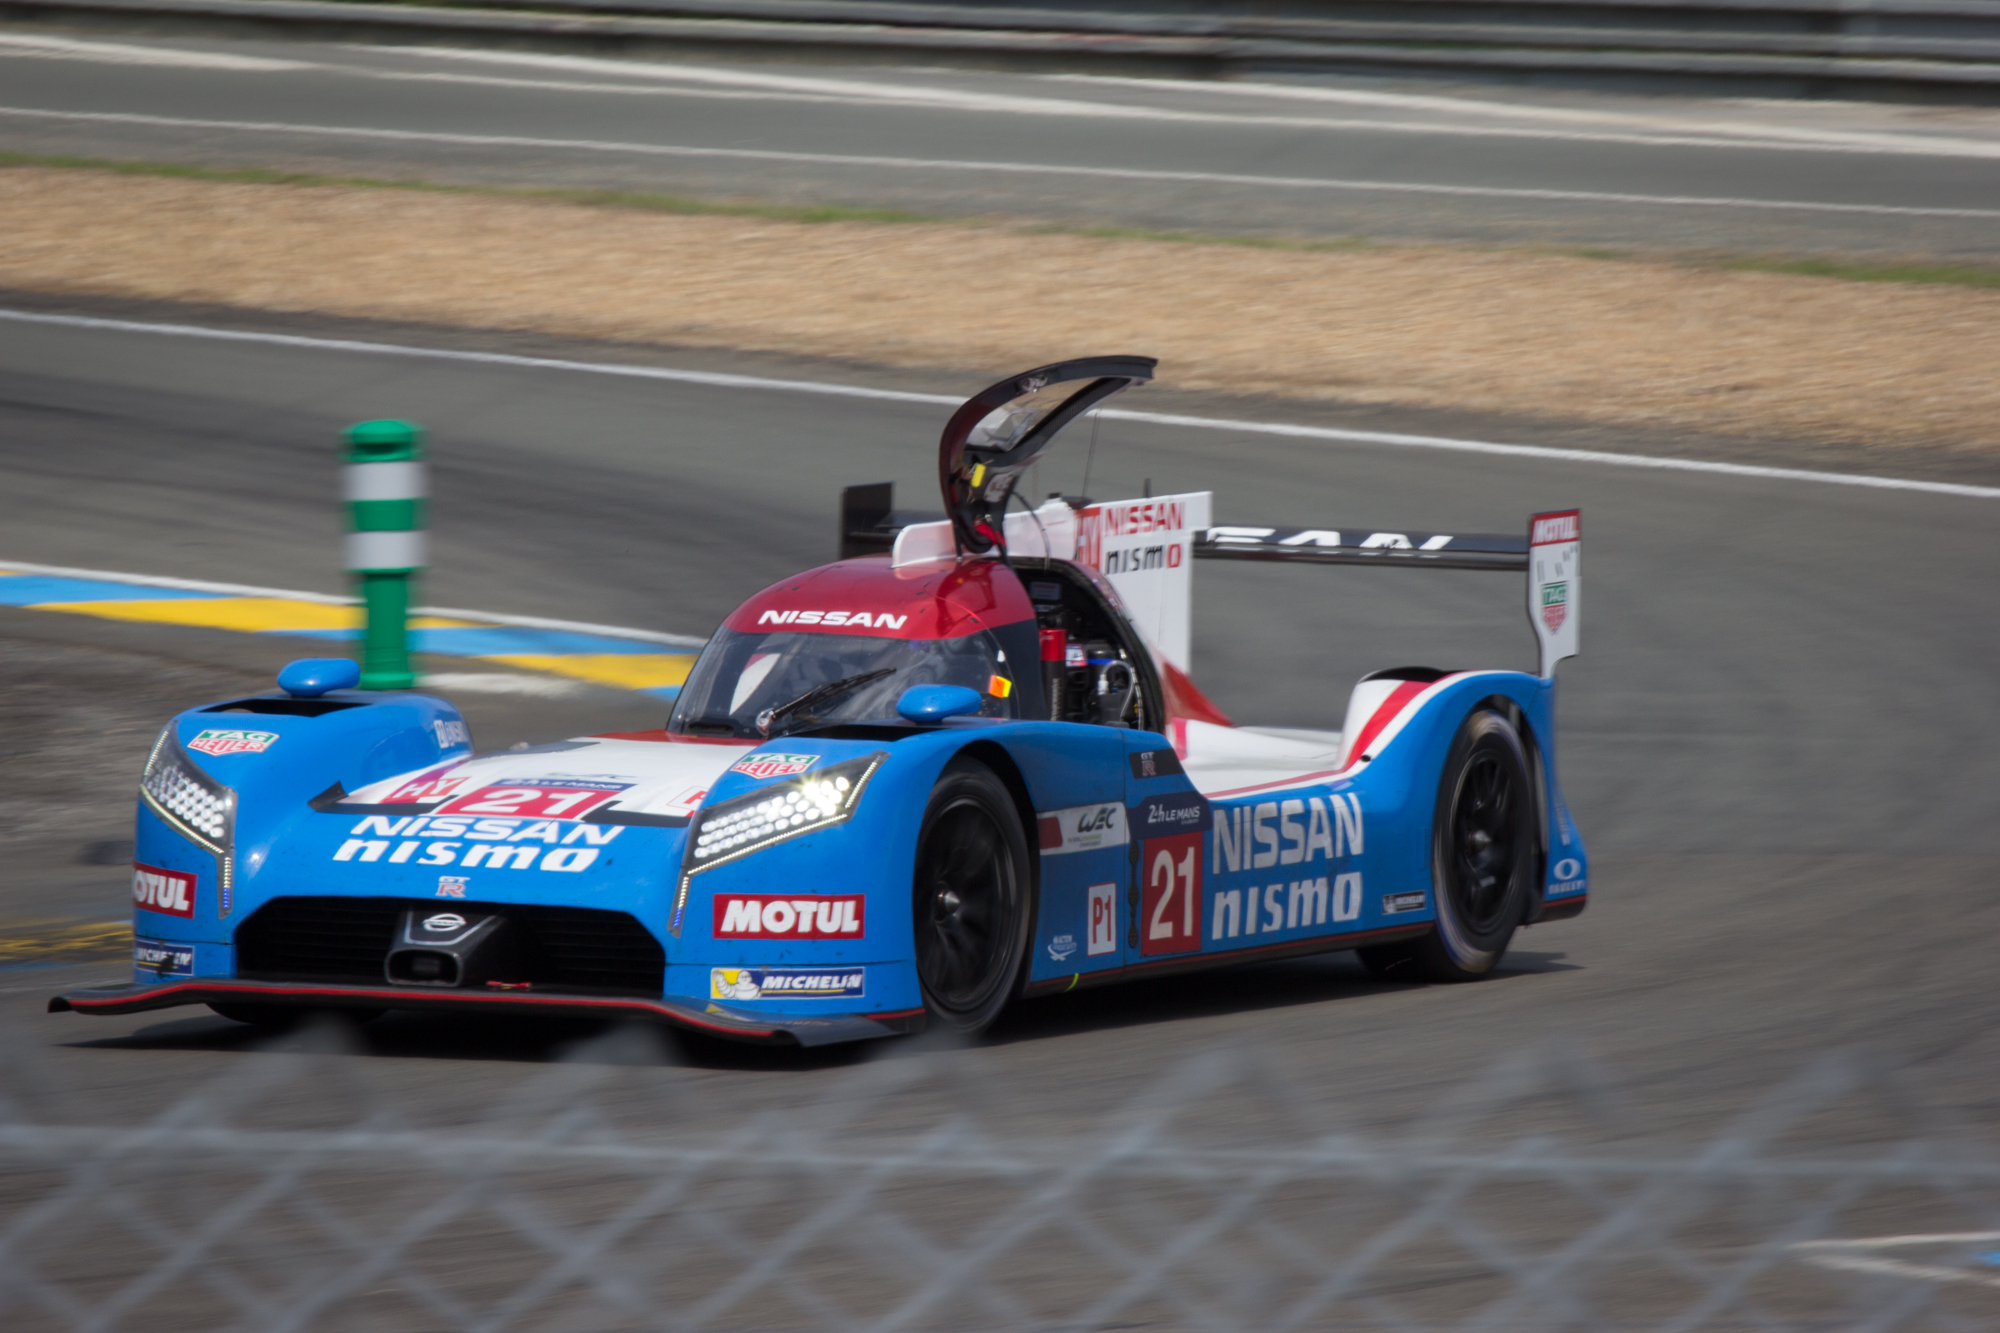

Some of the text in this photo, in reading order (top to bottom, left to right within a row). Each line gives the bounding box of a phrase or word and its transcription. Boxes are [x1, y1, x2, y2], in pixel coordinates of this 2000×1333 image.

[1105, 502, 1185, 537] NISSAN
[1532, 516, 1580, 543] MOTUL
[1105, 544, 1182, 575] nismo
[757, 610, 907, 630] NISSAN
[192, 739, 262, 753] HEUER
[205, 731, 269, 743] TAG
[752, 753, 813, 764] TAG
[1141, 752, 1155, 760] GT
[1142, 760, 1157, 777] R
[735, 762, 805, 777] HEUER
[392, 777, 466, 799] HY
[459, 788, 597, 815] 21
[1165, 809, 1177, 822] LE
[1176, 806, 1201, 820] MANS
[350, 816, 626, 845] NISSAN
[1077, 807, 1117, 833] WEC
[1212, 792, 1364, 875] NISSAN
[332, 839, 600, 873] nismo
[134, 869, 190, 911] OTUL
[435, 882, 466, 898] R
[438, 875, 471, 884] GT
[1149, 847, 1195, 940] 21
[1212, 872, 1364, 940] nismo
[720, 900, 860, 934] MOTUL
[1092, 895, 1112, 944] P1
[761, 974, 863, 989] MICHELIN
